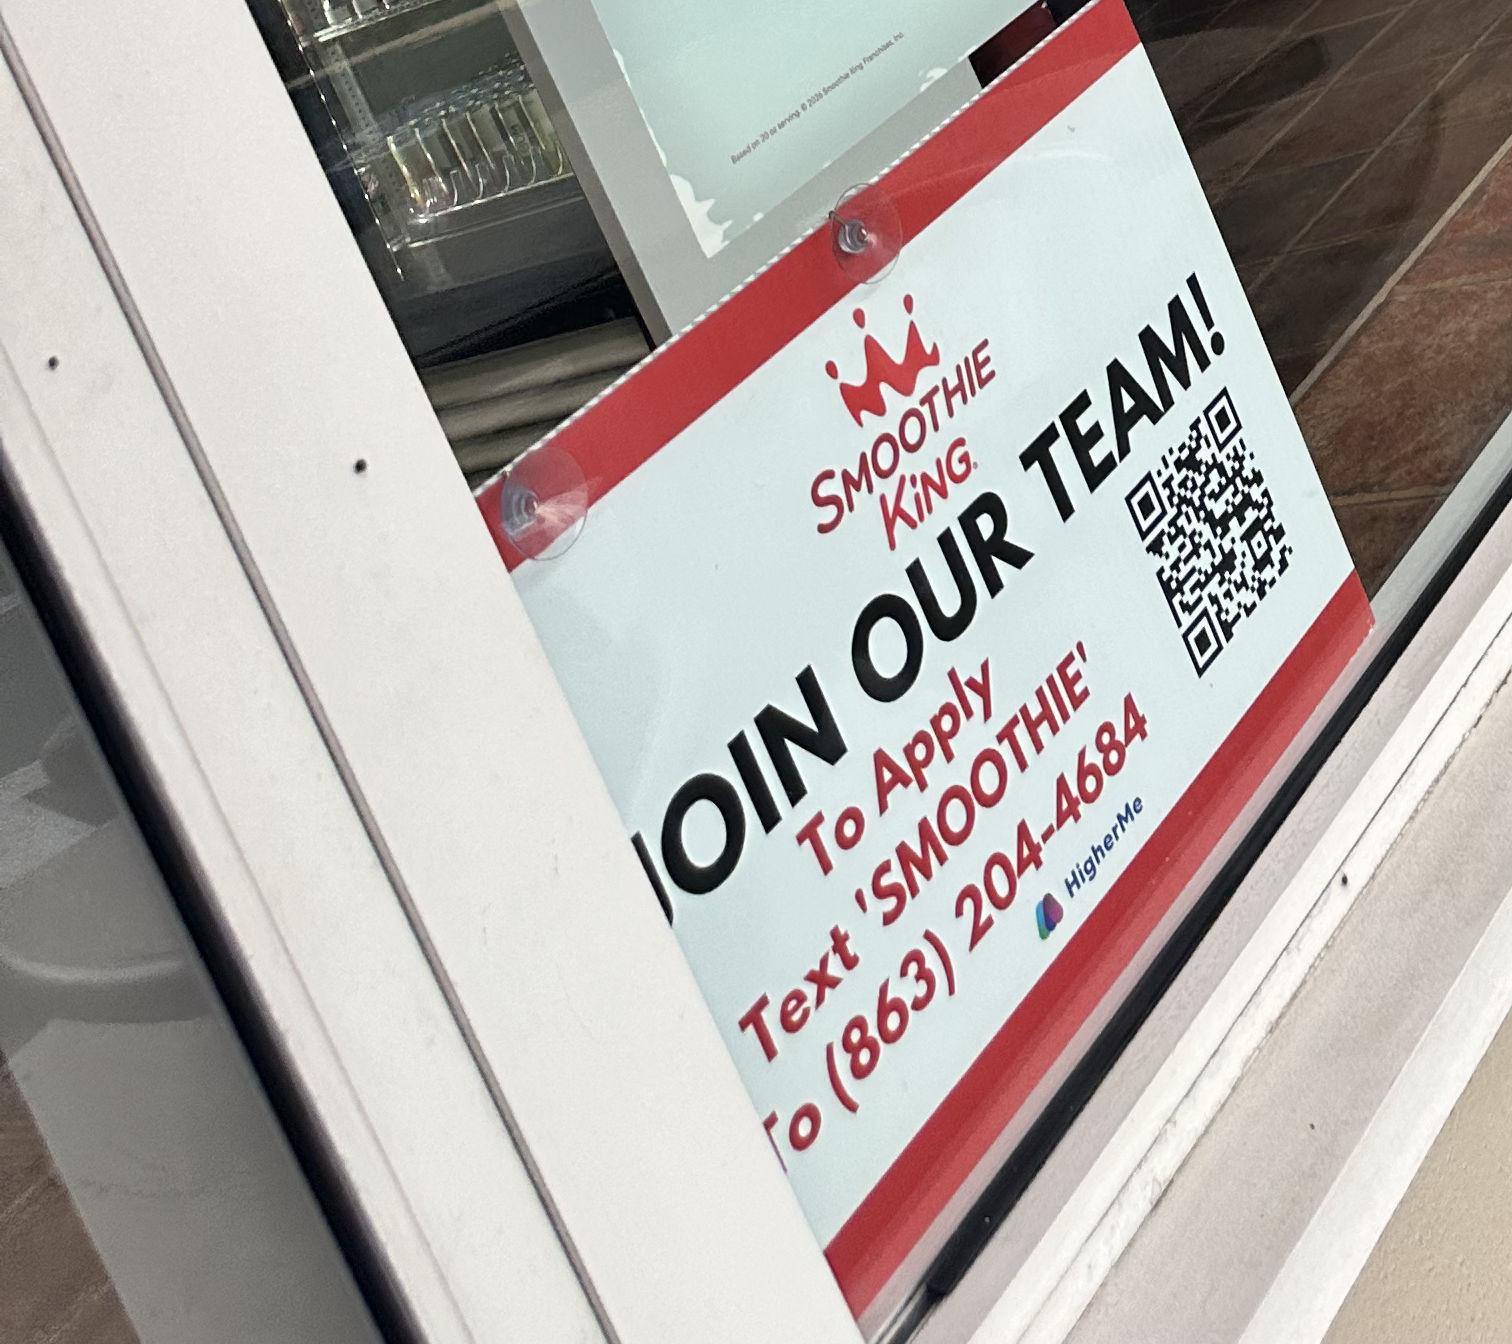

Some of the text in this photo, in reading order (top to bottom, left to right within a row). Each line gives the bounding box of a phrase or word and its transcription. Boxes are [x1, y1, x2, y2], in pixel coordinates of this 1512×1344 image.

[730, 144, 751, 164] Based
[760, 131, 770, 143] 20
[811, 338, 996, 535] SMOOTHIE
[851, 492, 1035, 703] OUR
[1019, 272, 1225, 523] TEAM!
[738, 640, 1091, 1062] Text 'SMOOTHIE'
[796, 657, 992, 876] To Apply
[1064, 796, 1144, 898] HigherMe
[826, 929, 956, 1114] (863)
[954, 692, 1148, 952] 204-4684
